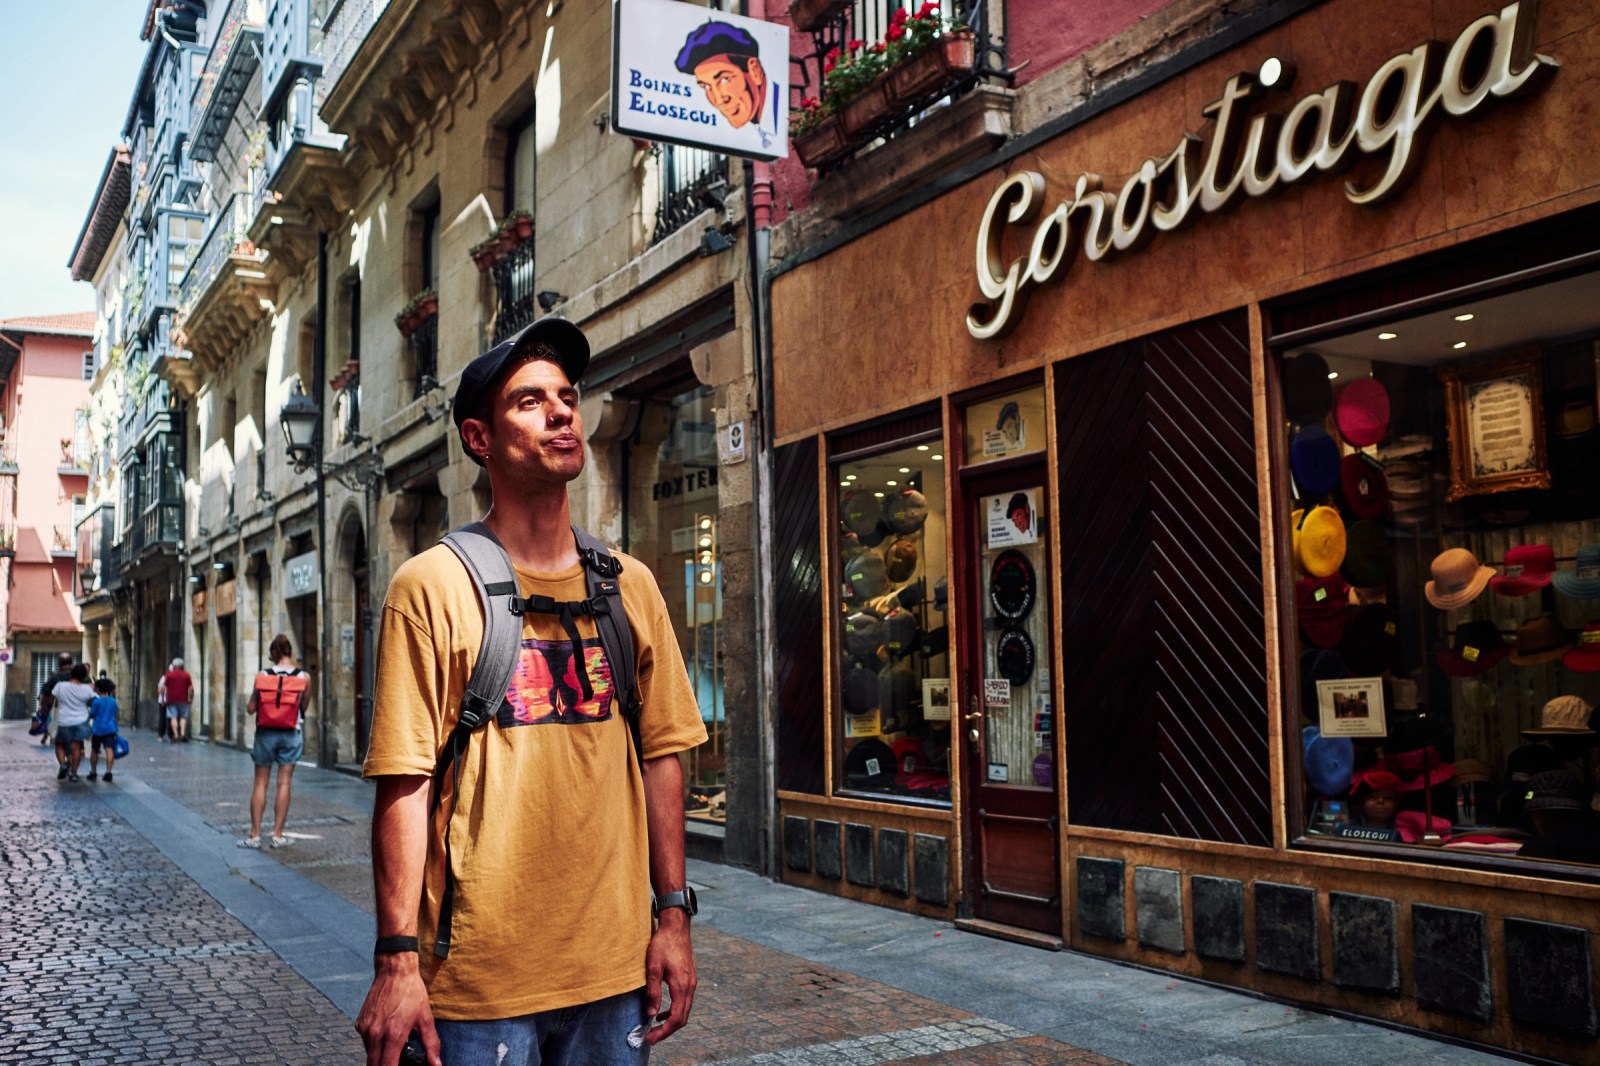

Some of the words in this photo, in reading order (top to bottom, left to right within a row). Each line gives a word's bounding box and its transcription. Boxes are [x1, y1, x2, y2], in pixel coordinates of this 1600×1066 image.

[629, 68, 692, 98] BOINAS
[628, 91, 717, 126] ELOSEGUI
[966, 1, 1560, 340] Gorostiaga
[1342, 828, 1389, 841] ELOSEGUI
